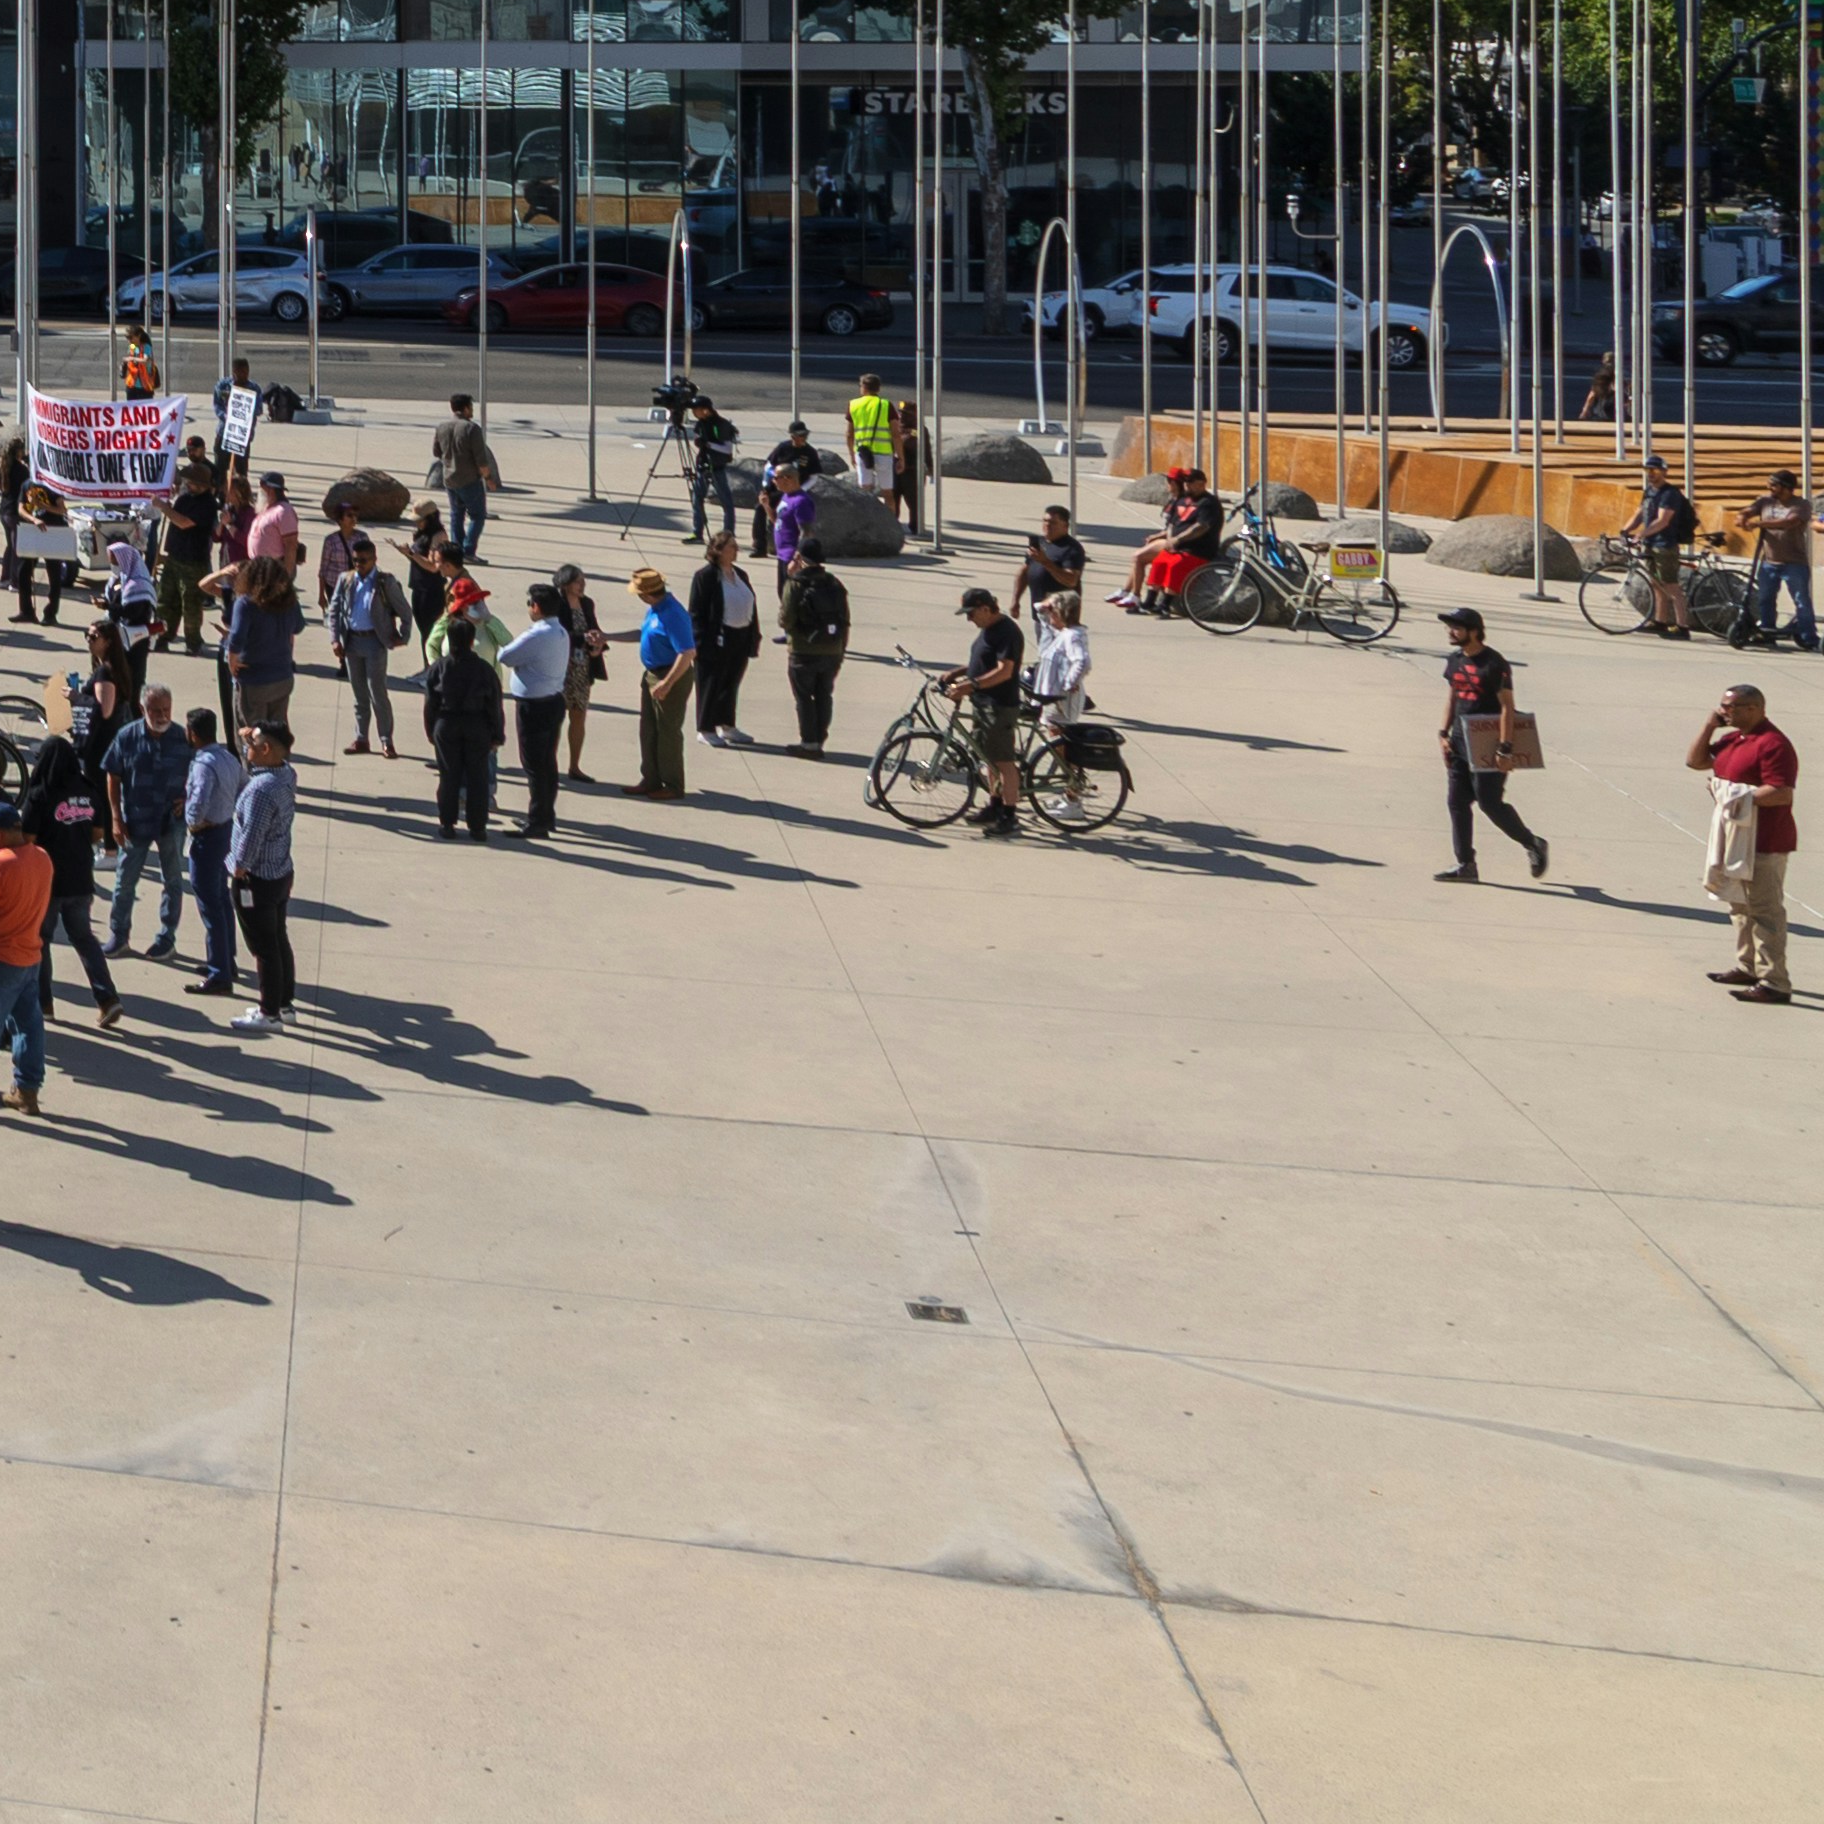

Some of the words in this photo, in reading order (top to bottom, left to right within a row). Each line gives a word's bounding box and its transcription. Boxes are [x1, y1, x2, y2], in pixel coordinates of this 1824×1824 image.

[33, 397, 115, 427] IMMIGRANTS
[121, 406, 161, 426] AND
[37, 424, 90, 450] WORKERS
[94, 428, 162, 451] RIGHTS
[96, 452, 126, 483] ONE
[130, 452, 170, 484] FIGHT
[1337, 552, 1372, 566] GABBY
